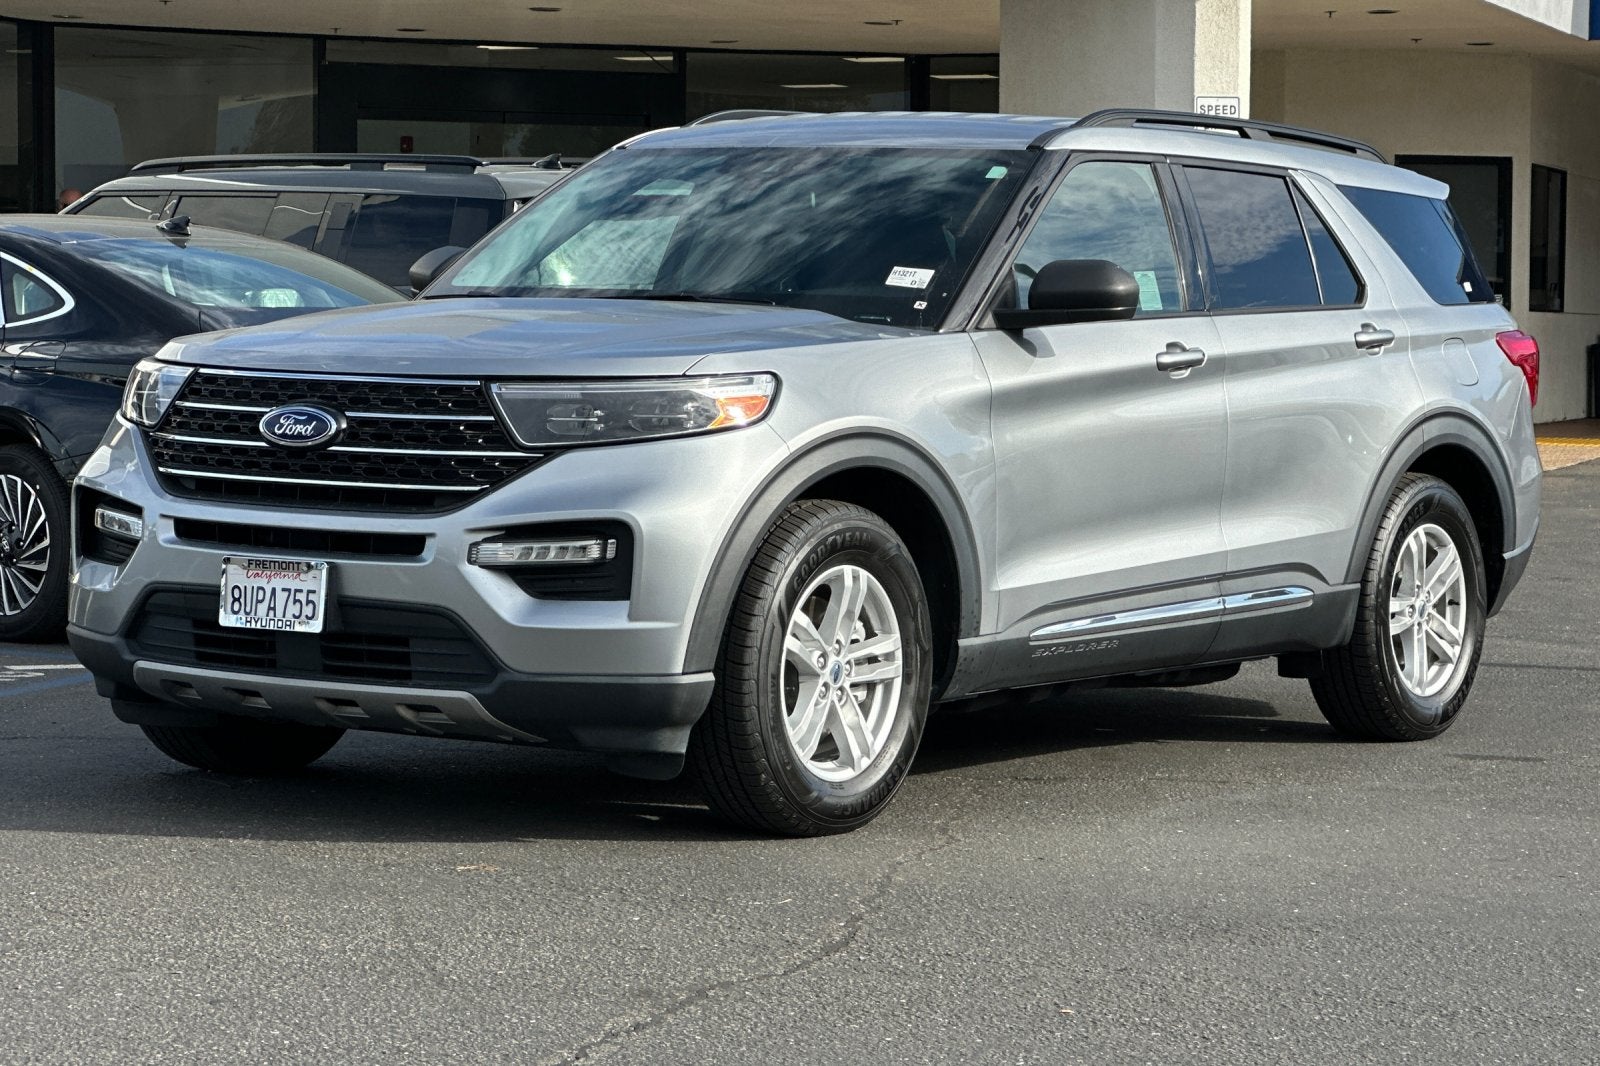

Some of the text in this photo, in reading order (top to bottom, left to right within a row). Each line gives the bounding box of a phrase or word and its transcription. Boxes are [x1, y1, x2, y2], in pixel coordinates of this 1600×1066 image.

[1199, 104, 1237, 115] SPEED
[274, 413, 317, 436] Ford
[247, 559, 302, 571] FREMONT
[793, 531, 871, 592] GOODYEAR
[246, 569, 308, 584] California
[230, 585, 317, 620] 8UPA755
[244, 617, 295, 630] HYUNDAI
[1032, 640, 1120, 657] EXPLORER
